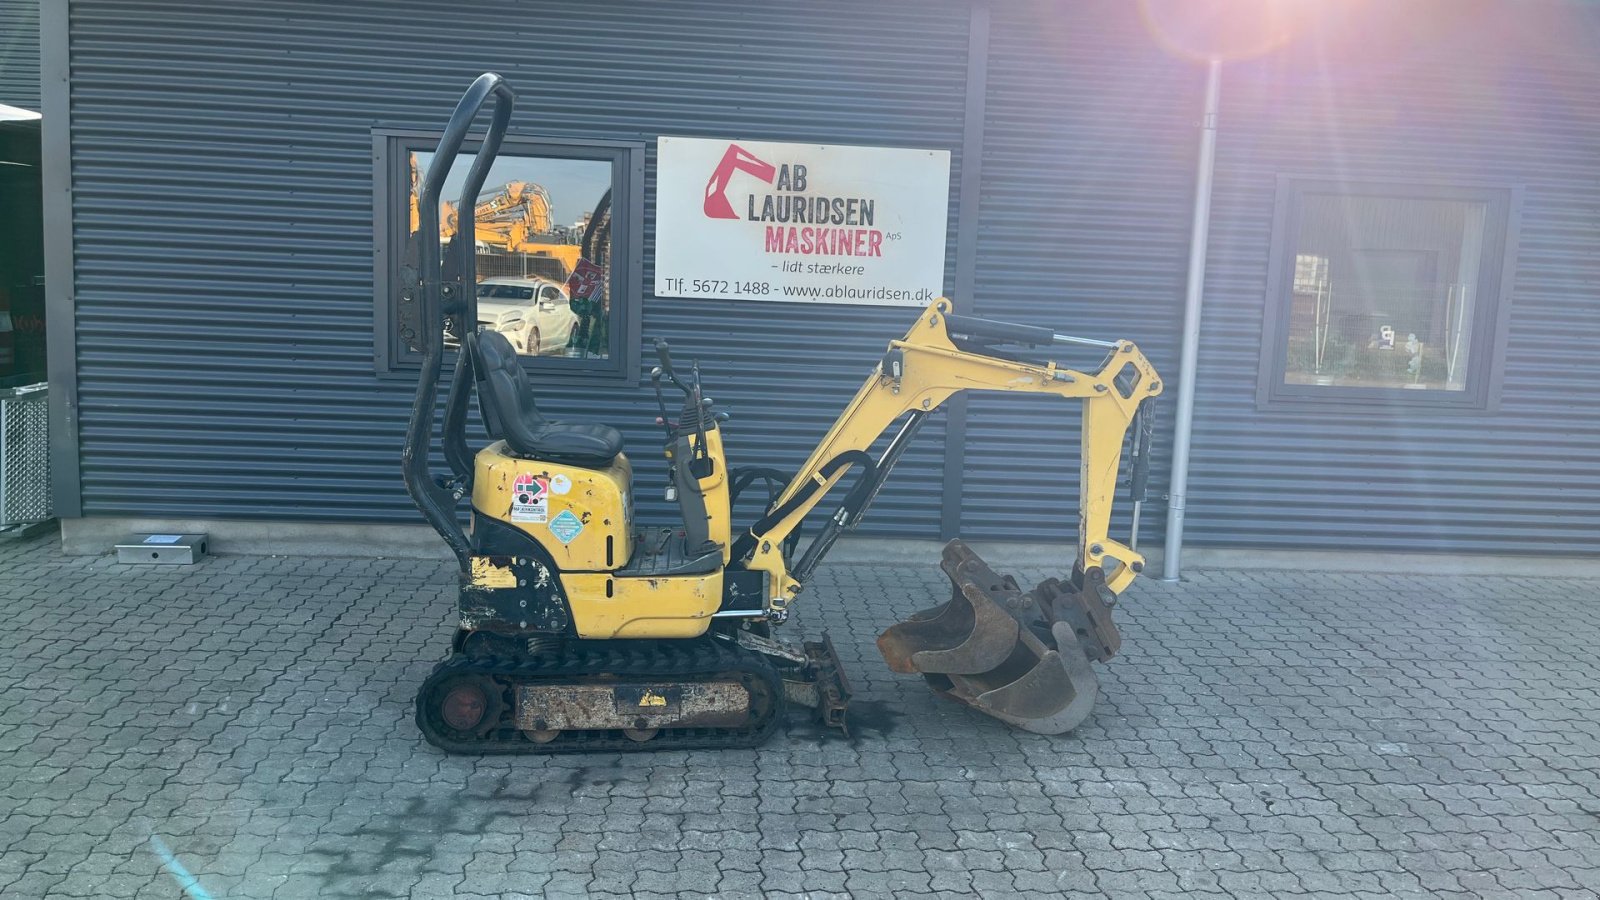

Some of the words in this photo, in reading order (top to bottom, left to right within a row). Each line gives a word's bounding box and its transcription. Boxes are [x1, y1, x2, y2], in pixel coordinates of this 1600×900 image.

[776, 163, 808, 192] AB
[748, 194, 875, 226] LAURIDSEN
[765, 225, 883, 257] MASKINER
[885, 231, 902, 241] ApS
[782, 260, 803, 273] lidt
[807, 262, 865, 276] stærkere
[665, 278, 687, 295] Tlf.
[692, 279, 729, 294] 5672
[733, 281, 770, 295] 1488
[782, 284, 934, 301] www.ablauridsen.dk
